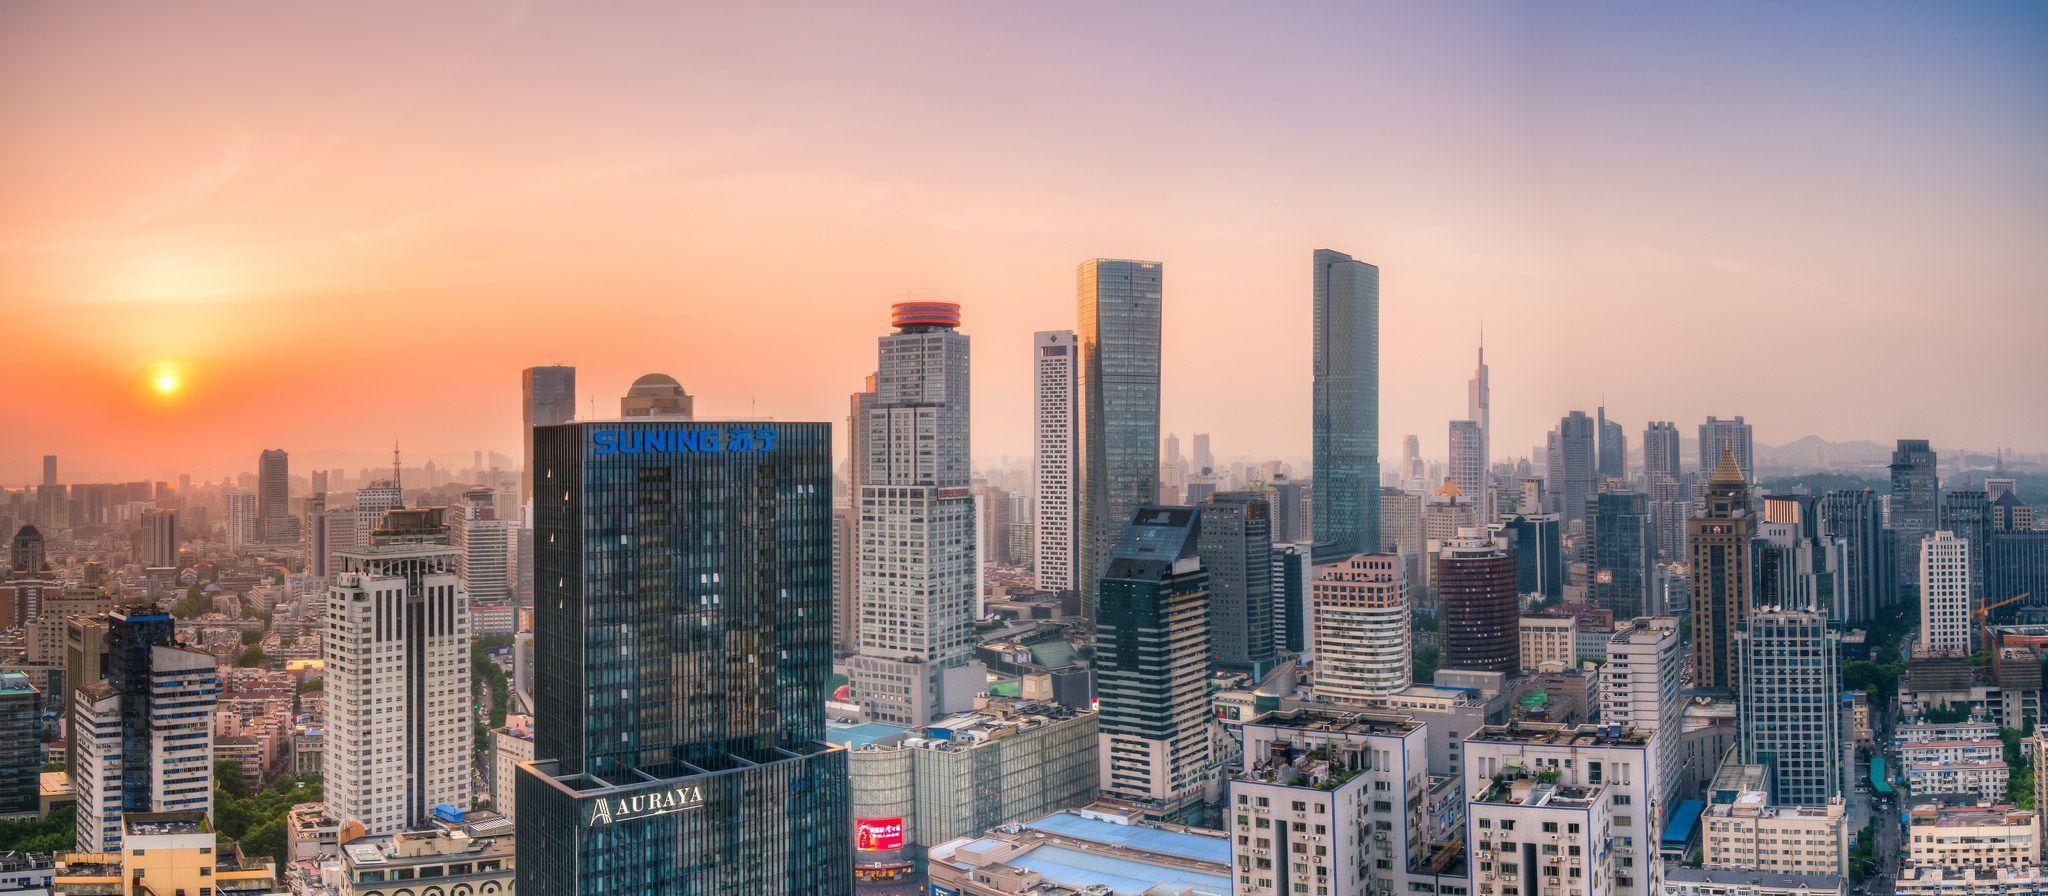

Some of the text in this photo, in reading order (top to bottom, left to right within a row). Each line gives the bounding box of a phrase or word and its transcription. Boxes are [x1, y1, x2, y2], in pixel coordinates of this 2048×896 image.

[593, 428, 779, 455] SUNING 苏宁
[616, 786, 703, 816] AURAYA
